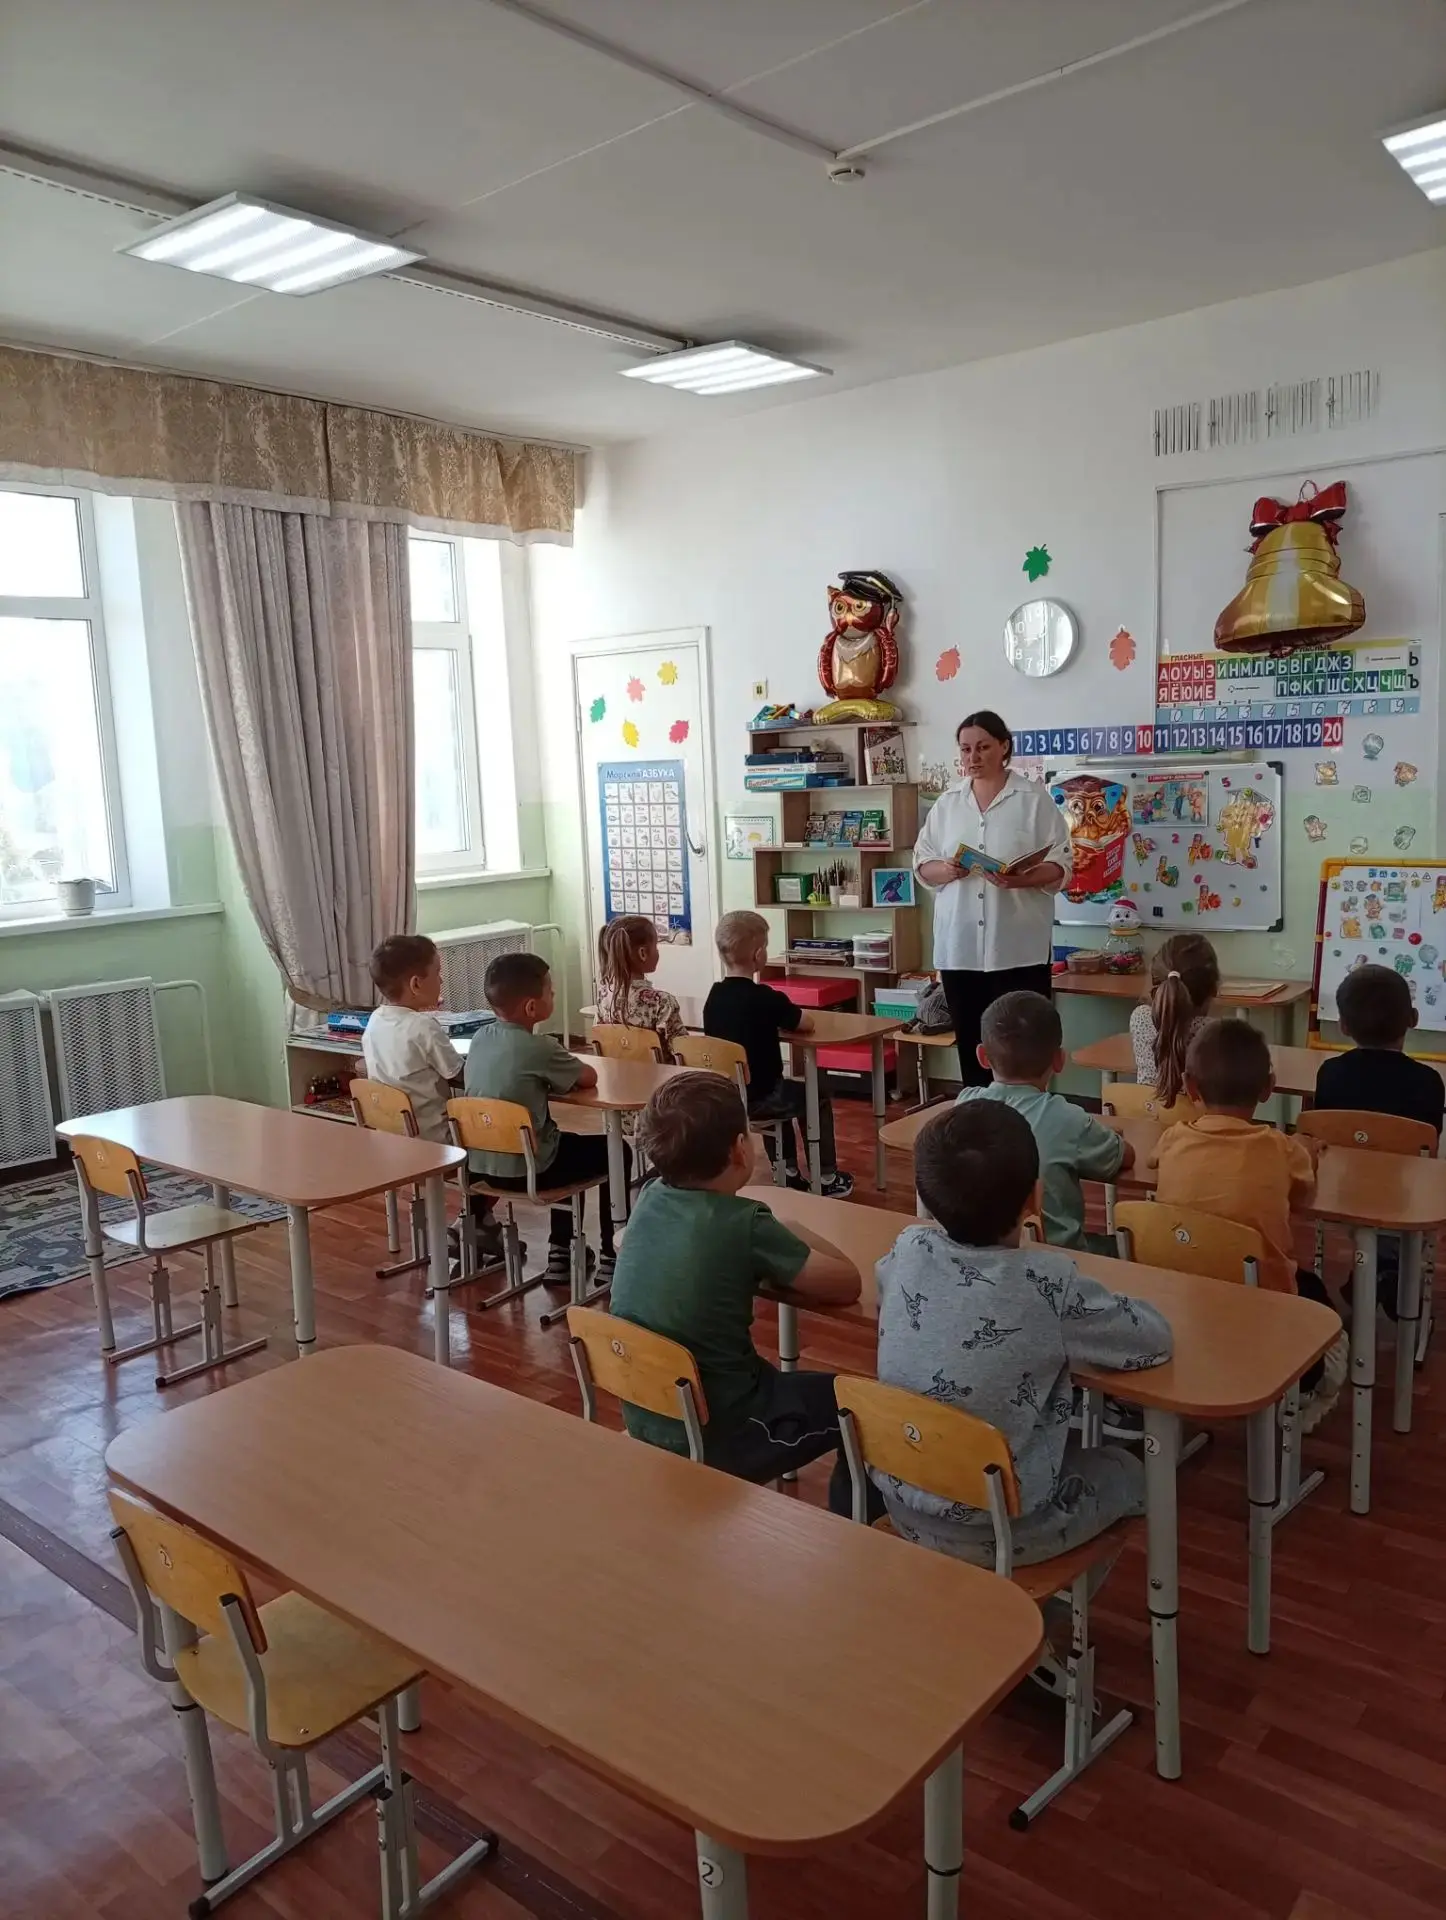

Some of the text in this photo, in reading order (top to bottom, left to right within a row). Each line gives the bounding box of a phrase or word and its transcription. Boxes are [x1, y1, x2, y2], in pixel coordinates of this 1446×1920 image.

[1015, 648, 1023, 660] 8
[1170, 653, 1204, 662] ГЛАСНЫЕ
[1026, 657, 1033, 669] 7
[1049, 655, 1058, 667] 5
[1024, 735, 1033, 753] 2
[1038, 734, 1047, 752] 3
[1052, 733, 1062, 751] 4
[1067, 733, 1075, 751] 5
[1080, 732, 1089, 750] 6
[1095, 731, 1104, 749] 7
[1109, 731, 1118, 749] 8
[1124, 730, 1133, 748] 9
[1137, 730, 1151, 748] 10
[1156, 729, 1169, 748] 11
[1173, 728, 1188, 747] 12
[1191, 727, 1206, 746] 13
[1209, 726, 1225, 746] 14
[1228, 725, 1243, 745] 15
[1246, 725, 1263, 744] 16
[1266, 724, 1282, 743] 17
[1285, 723, 1301, 743] 18
[1304, 723, 1321, 742] 19
[1323, 722, 1342, 743] 20
[1171, 833, 1180, 844] 2
[1355, 1251, 1364, 1265] 2
[1146, 1438, 1156, 1454] 2
[701, 1860, 715, 1886] 2
